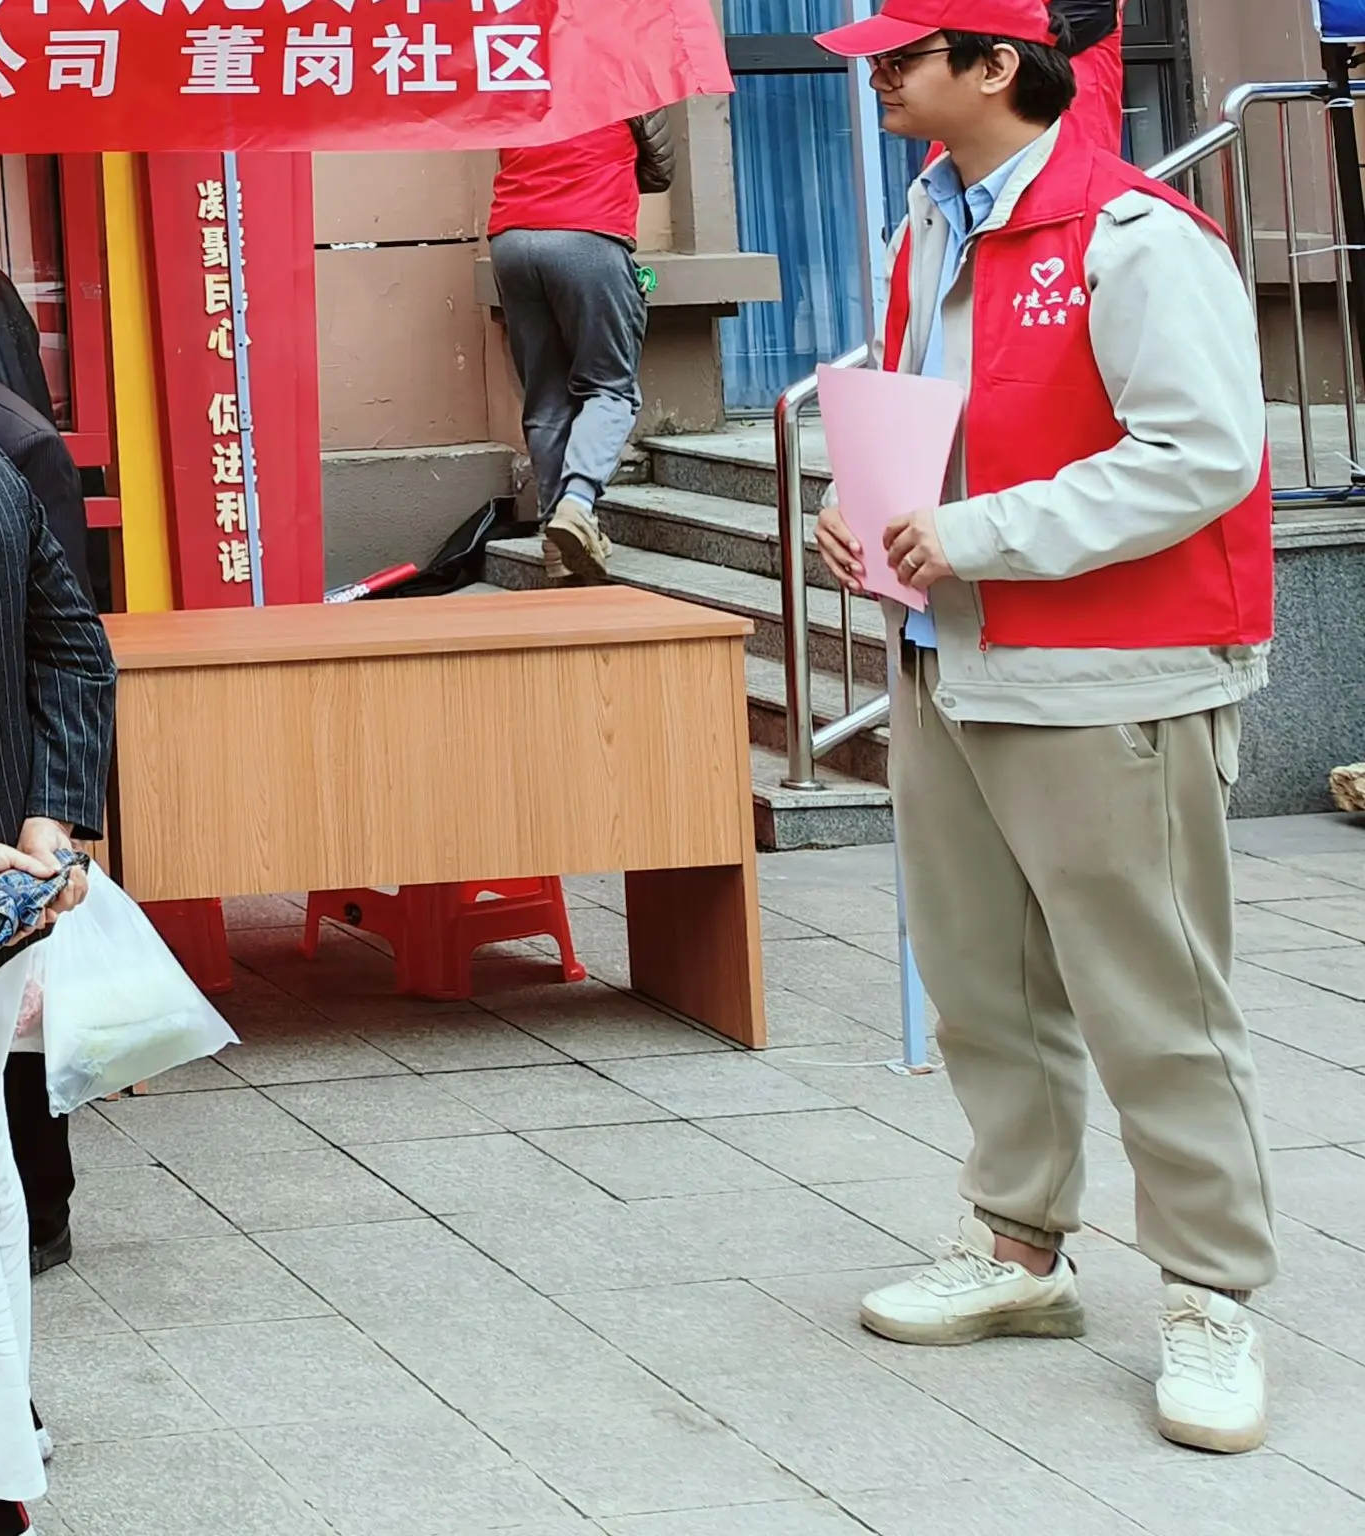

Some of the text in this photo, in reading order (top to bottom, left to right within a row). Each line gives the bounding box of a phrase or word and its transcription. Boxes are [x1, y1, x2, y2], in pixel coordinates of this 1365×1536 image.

[180, 22, 552, 96] 董岗社区
[1012, 285, 1087, 313] 中建二局
